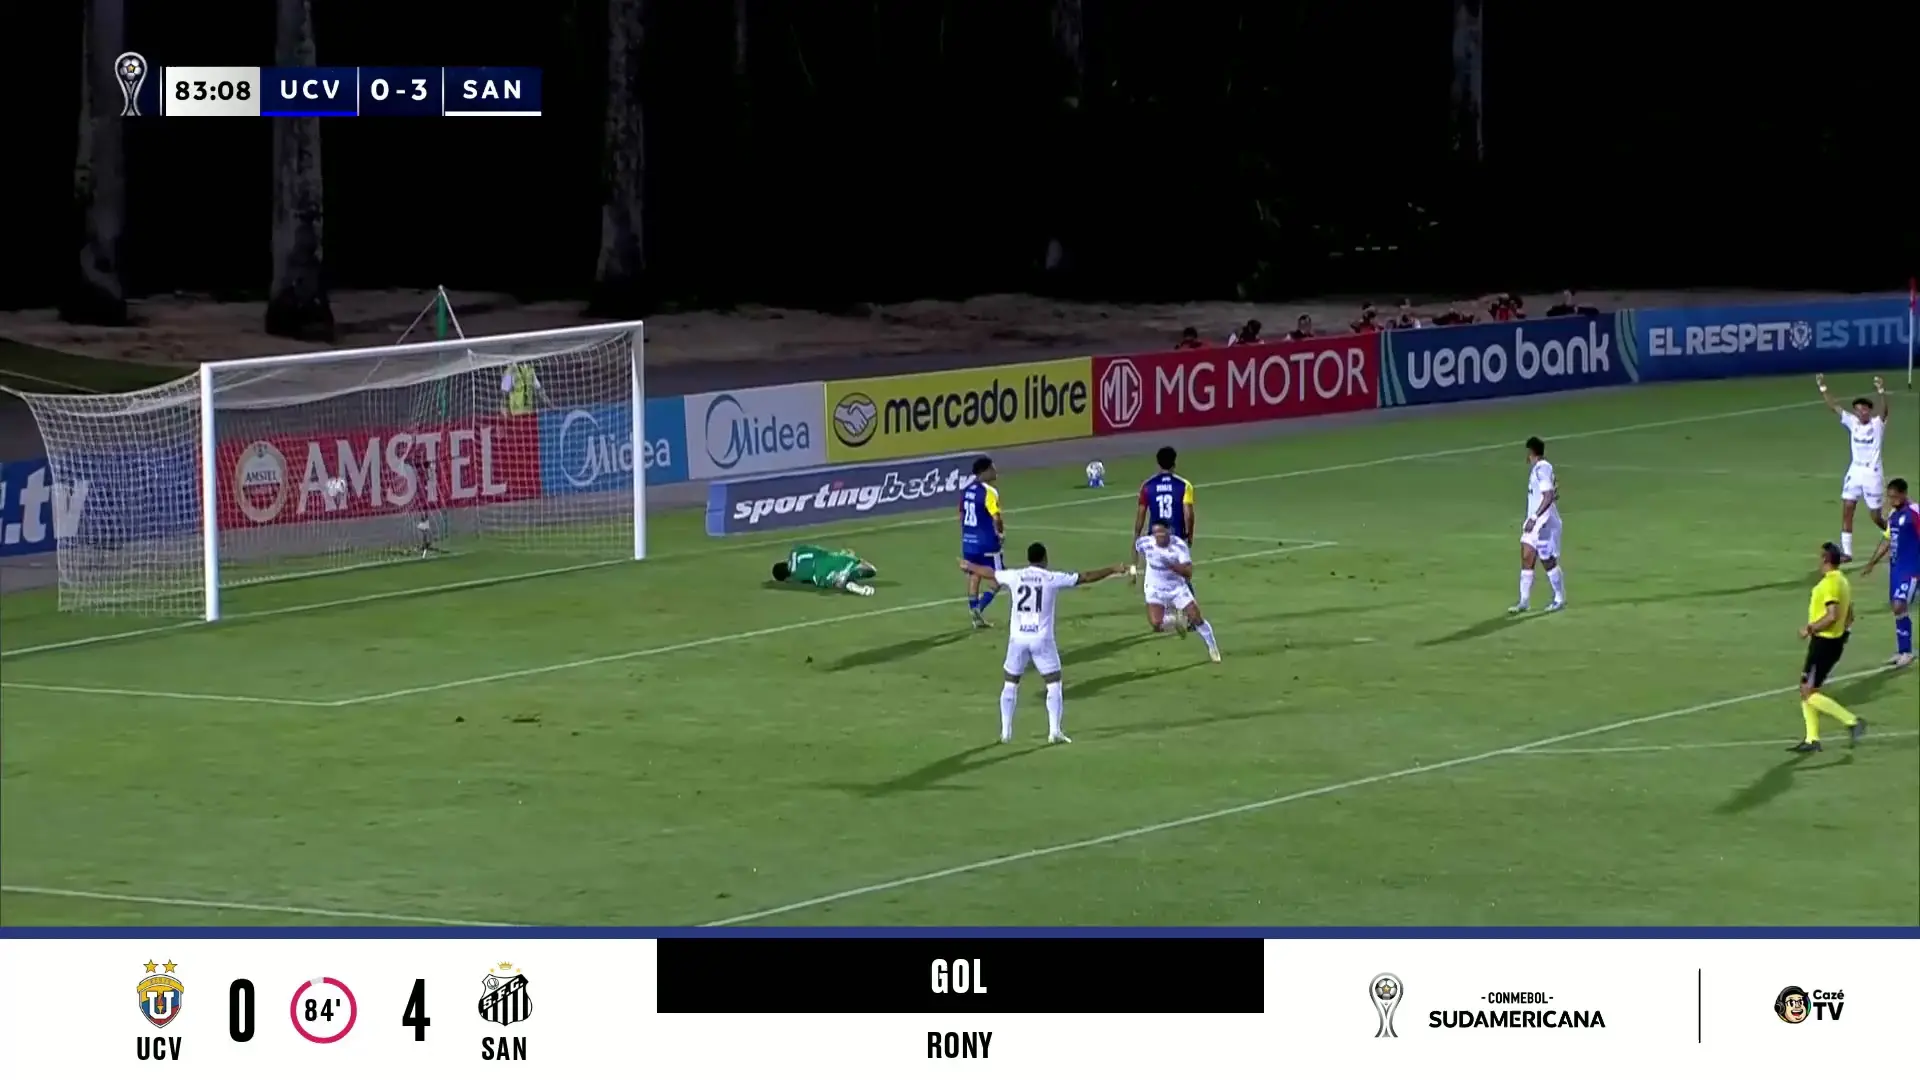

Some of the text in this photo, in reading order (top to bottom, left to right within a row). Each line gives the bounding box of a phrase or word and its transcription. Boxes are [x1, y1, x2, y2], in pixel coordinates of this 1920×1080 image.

[1408, 321, 1610, 389] ueno bank
[1650, 328, 1682, 356] EL
[1816, 320, 1849, 348] ES
[1853, 316, 1920, 346] TITU
[884, 375, 1087, 434] mercado libre
[1155, 347, 1369, 414] MG MOTOR
[724, 415, 810, 460] Midea
[246, 470, 277, 482] AMSTEL
[297, 427, 507, 515] AMSTEL
[733, 468, 977, 524] sportingbet.tv
[0, 467, 90, 544] .tv
[1155, 494, 1173, 519] 13
[1017, 584, 1043, 613] 21
